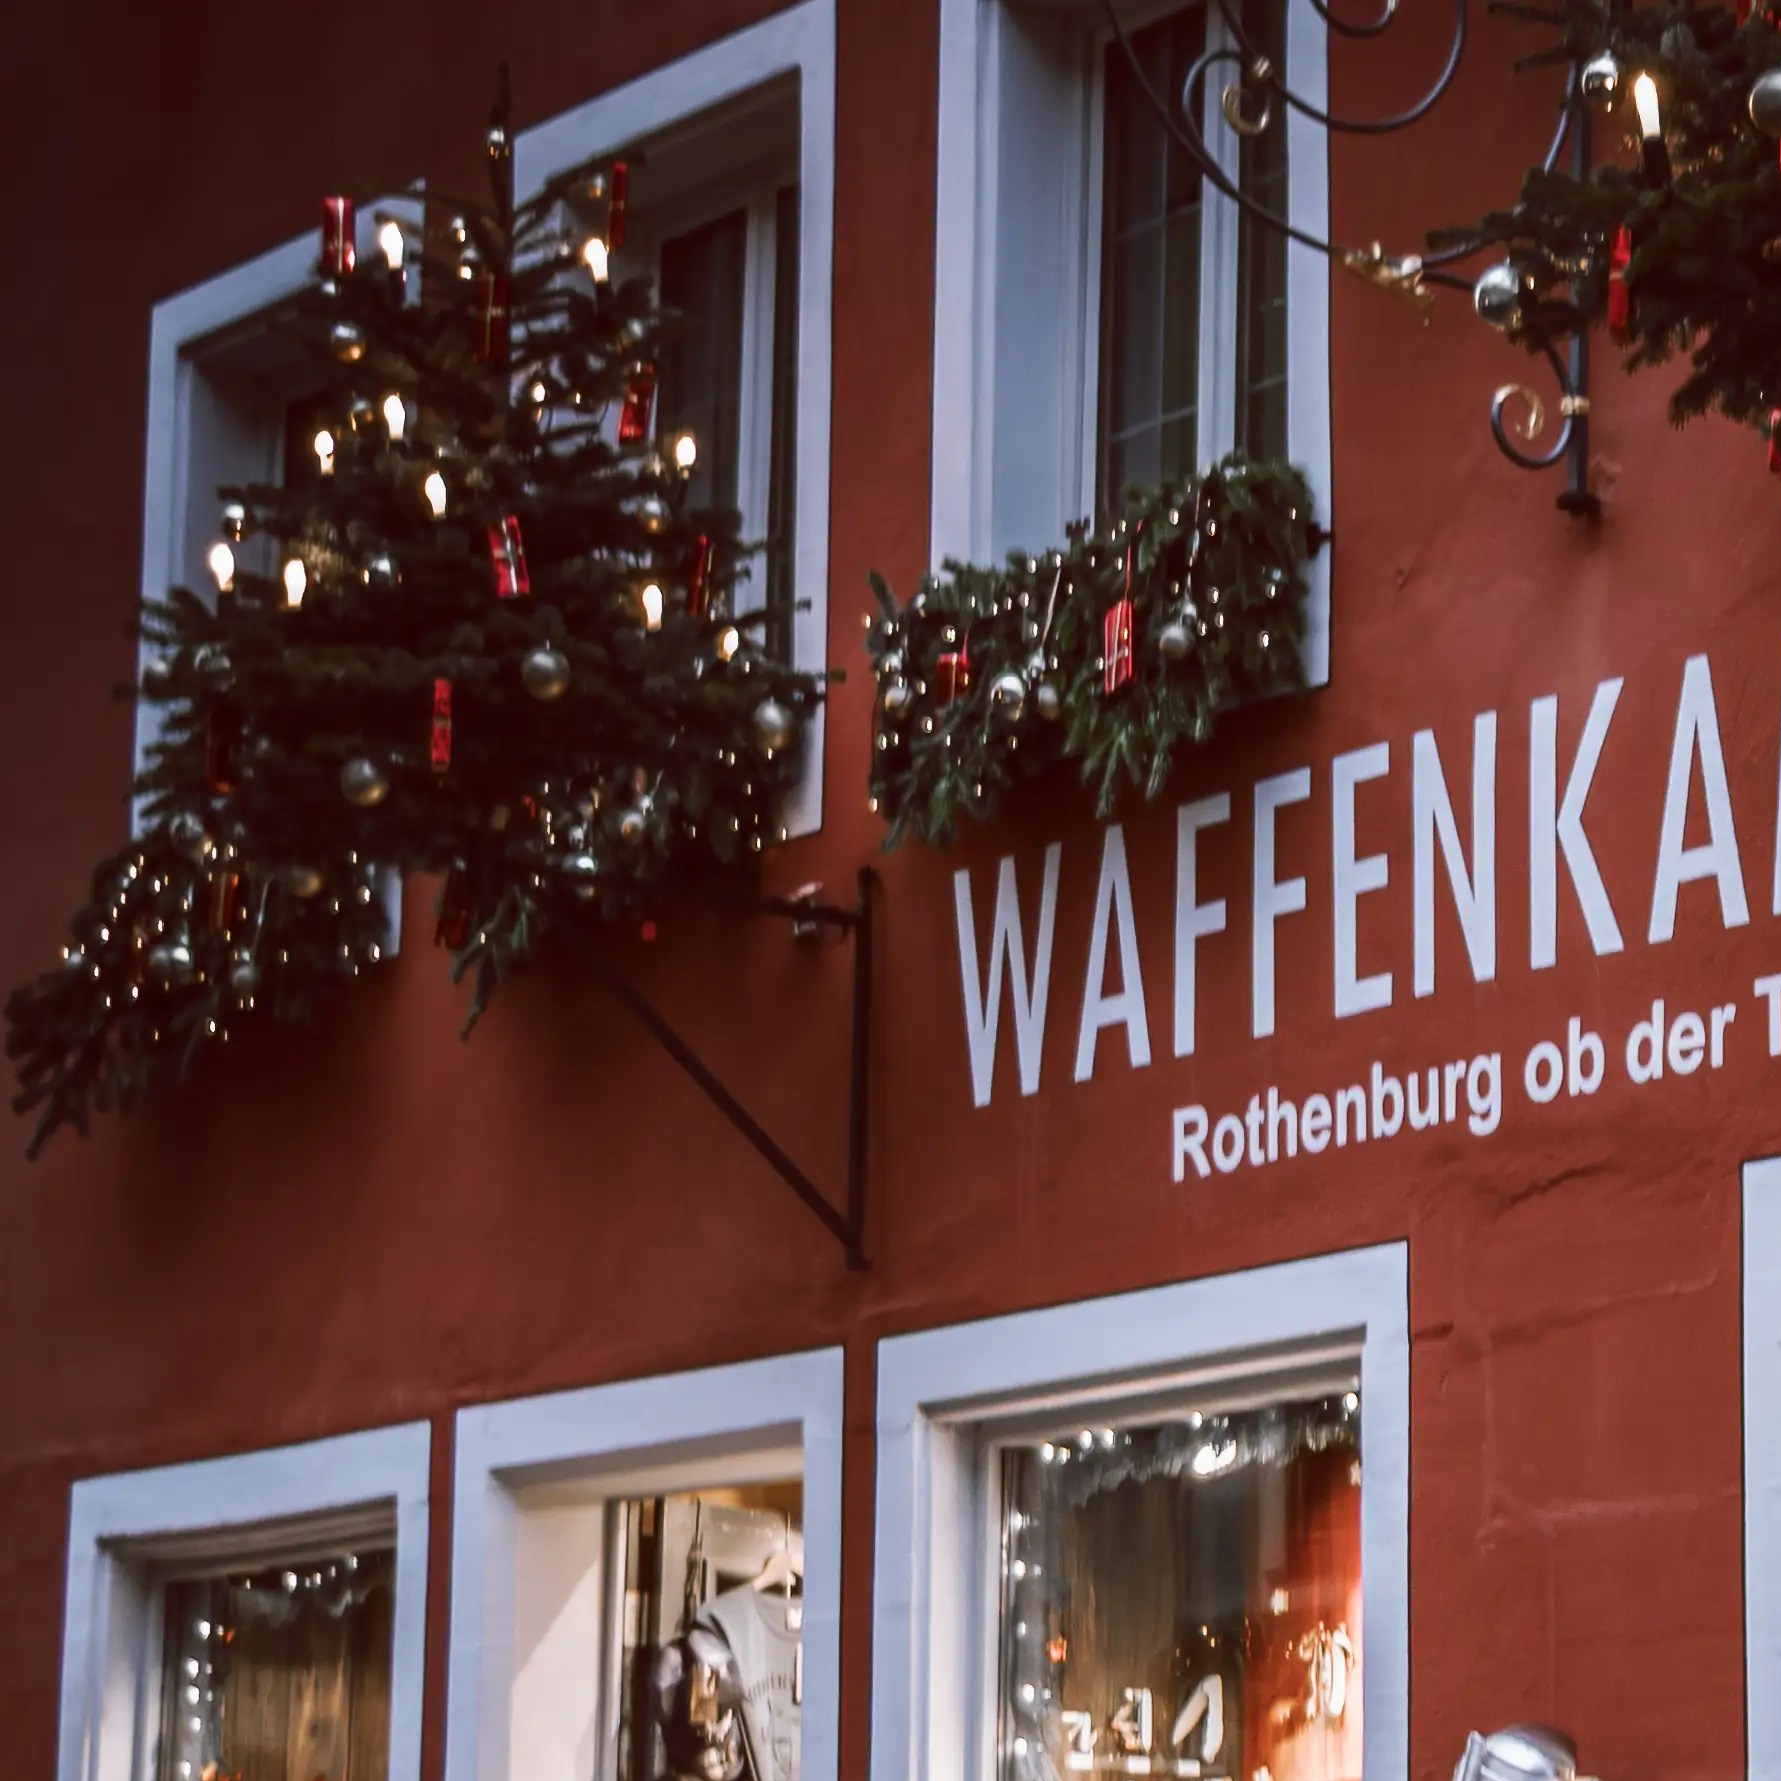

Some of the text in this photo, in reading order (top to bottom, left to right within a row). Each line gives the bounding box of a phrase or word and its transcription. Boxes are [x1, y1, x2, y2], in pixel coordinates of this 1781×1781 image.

[1172, 1052, 1503, 1184] Rothenburg
[1523, 1015, 1605, 1104] ob
[1625, 999, 1737, 1086] der
